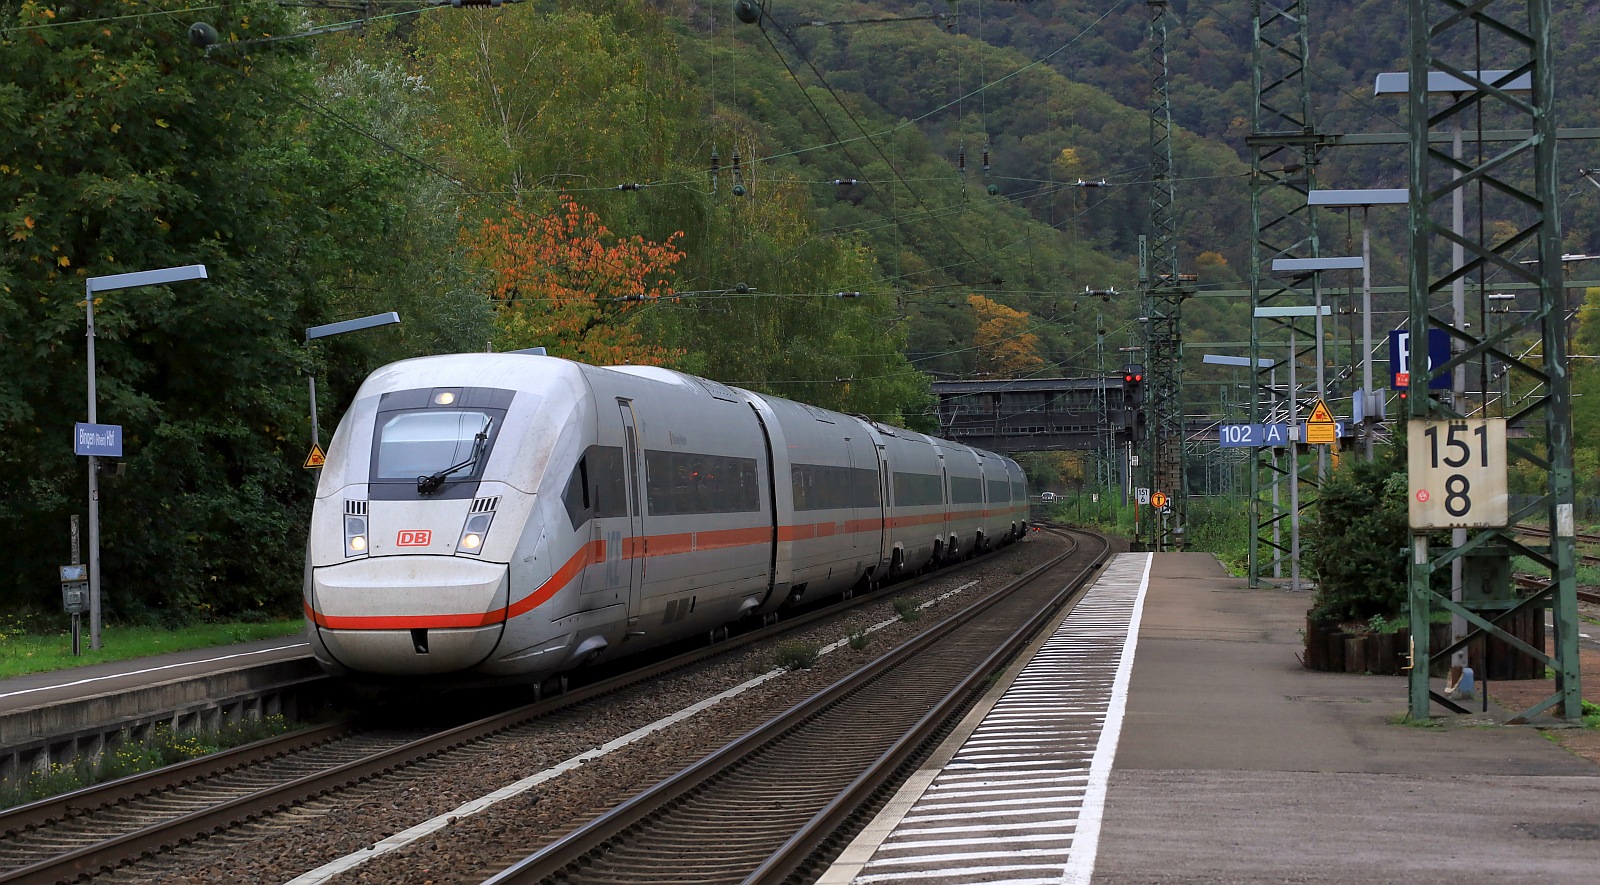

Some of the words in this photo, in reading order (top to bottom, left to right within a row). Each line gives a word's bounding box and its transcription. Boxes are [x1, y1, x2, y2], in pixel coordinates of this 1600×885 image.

[80, 428, 95, 449] Bingen
[106, 430, 114, 446] Hbf
[1222, 425, 1252, 443] 102
[1267, 424, 1281, 441] A
[1424, 424, 1488, 469] 151
[1444, 473, 1472, 518] 8
[400, 532, 427, 544] DB
